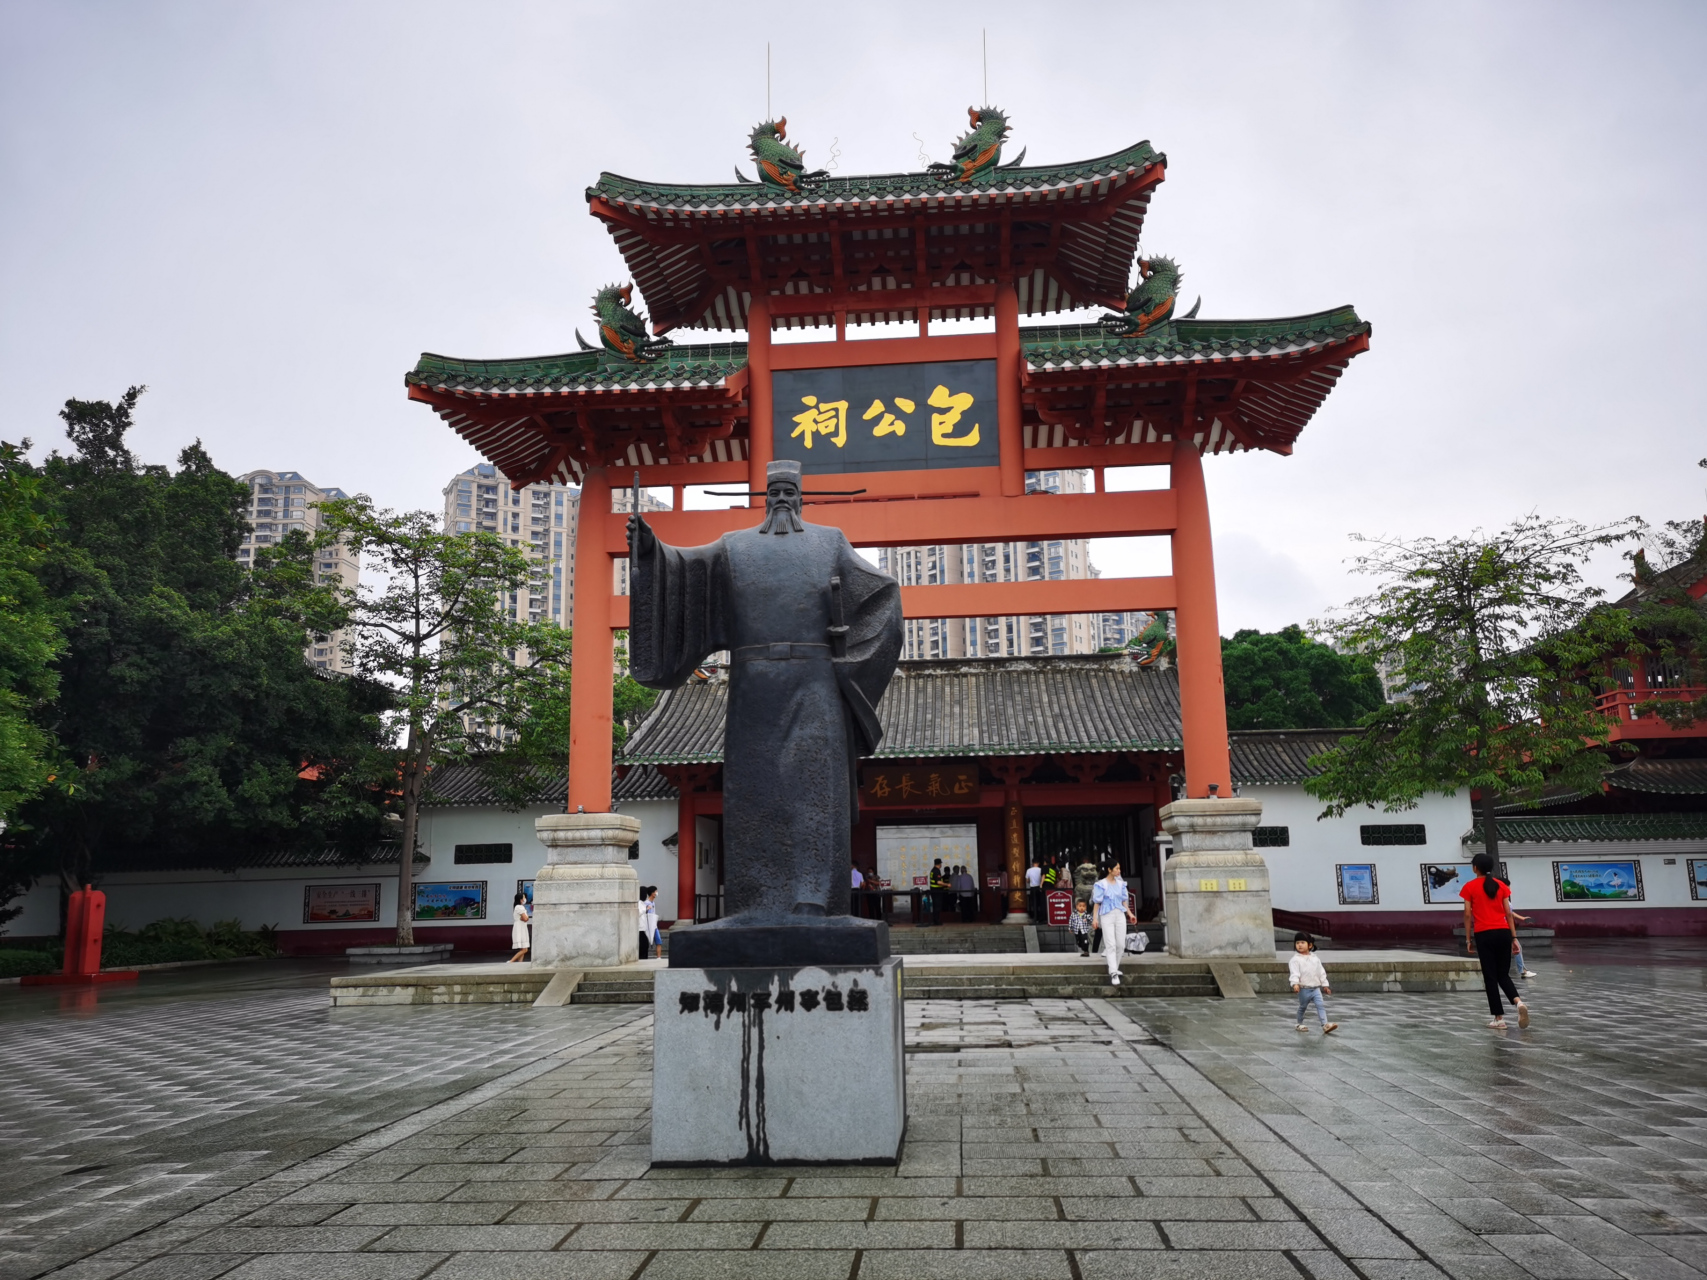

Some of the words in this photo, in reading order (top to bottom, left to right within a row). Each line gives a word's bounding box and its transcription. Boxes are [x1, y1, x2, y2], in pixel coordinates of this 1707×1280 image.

[790, 384, 981, 449] 包公祠
[870, 772, 974, 799] 正氣長存
